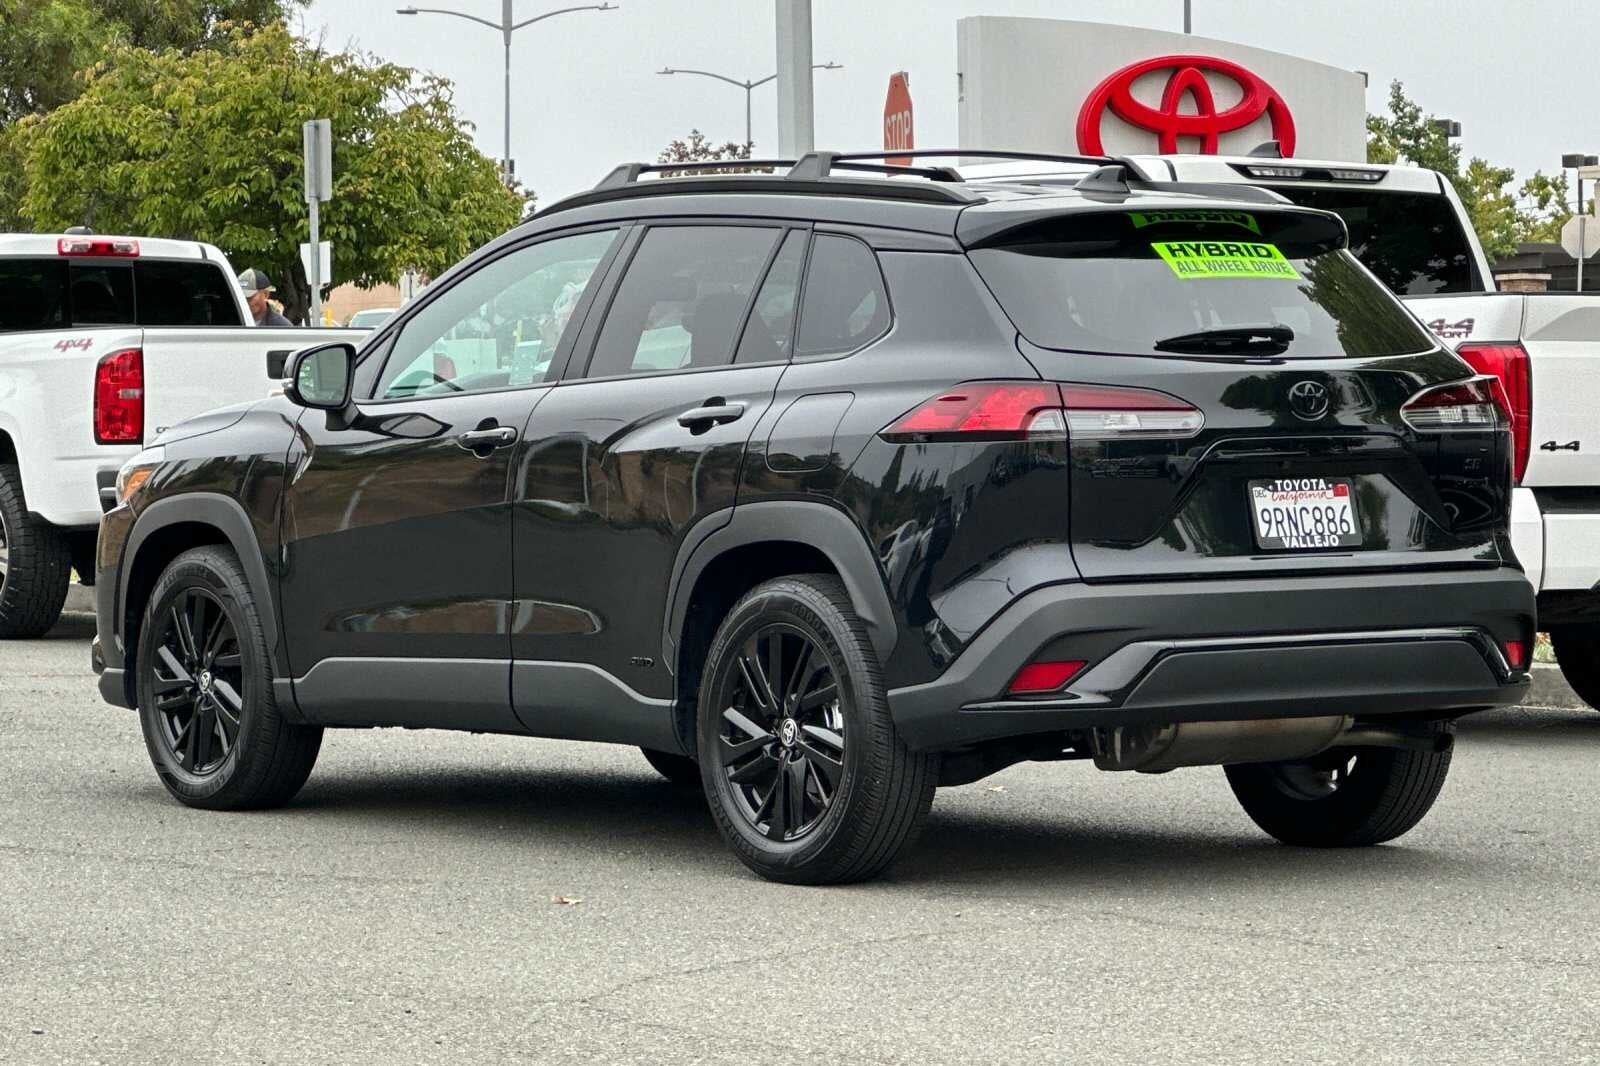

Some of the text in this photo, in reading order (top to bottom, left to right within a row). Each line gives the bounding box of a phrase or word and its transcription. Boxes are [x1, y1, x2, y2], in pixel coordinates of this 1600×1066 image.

[886, 110, 911, 150] STOP
[1165, 243, 1273, 258] HYBRID
[1176, 260, 1290, 273] ALL WHEEL DRIVE
[1274, 478, 1327, 492] TOYOTA
[1260, 504, 1351, 537] 9RNC886
[1281, 534, 1339, 548] VALLEJO
